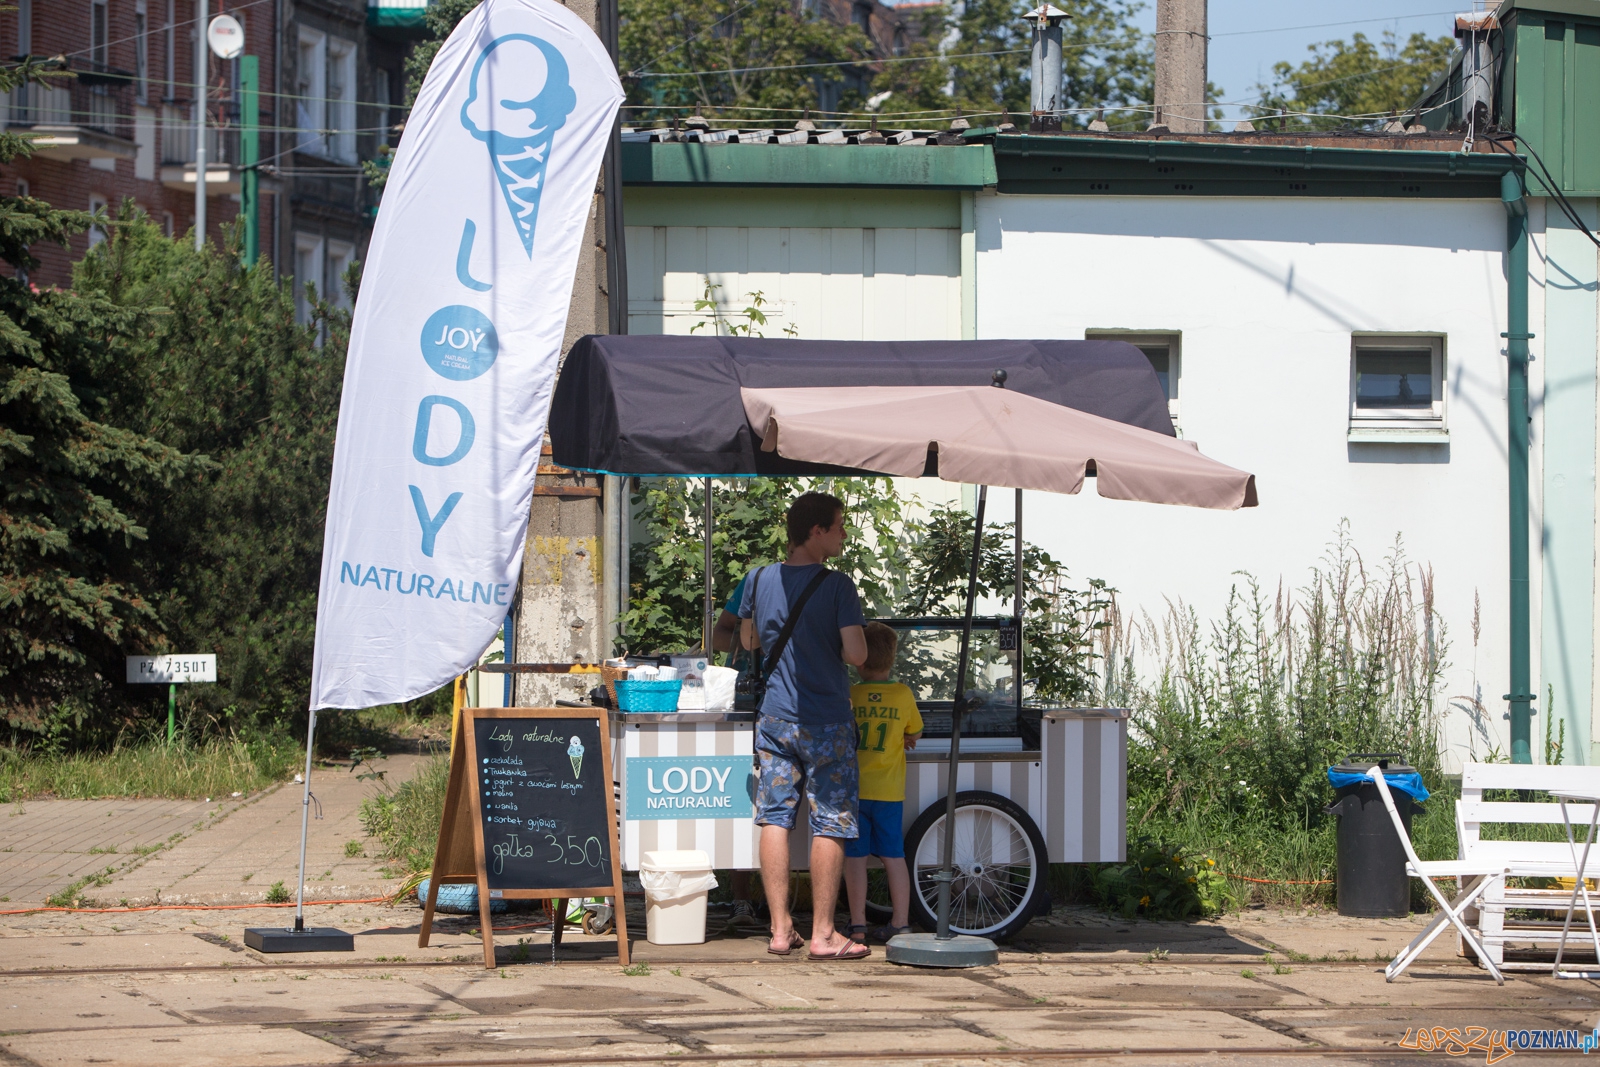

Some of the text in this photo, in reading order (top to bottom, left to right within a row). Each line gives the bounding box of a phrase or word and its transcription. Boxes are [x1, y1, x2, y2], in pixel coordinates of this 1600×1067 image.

[444, 354, 469, 363] NATURAL
[450, 361, 471, 370] CREAM
[340, 561, 509, 606] NATURALNE
[140, 661, 154, 674] PZ
[488, 725, 565, 752] Lody naturalne
[858, 721, 888, 752] 11
[492, 777, 514, 790] jogurt
[647, 766, 732, 794] LODY
[647, 796, 732, 809] NATURALNE
